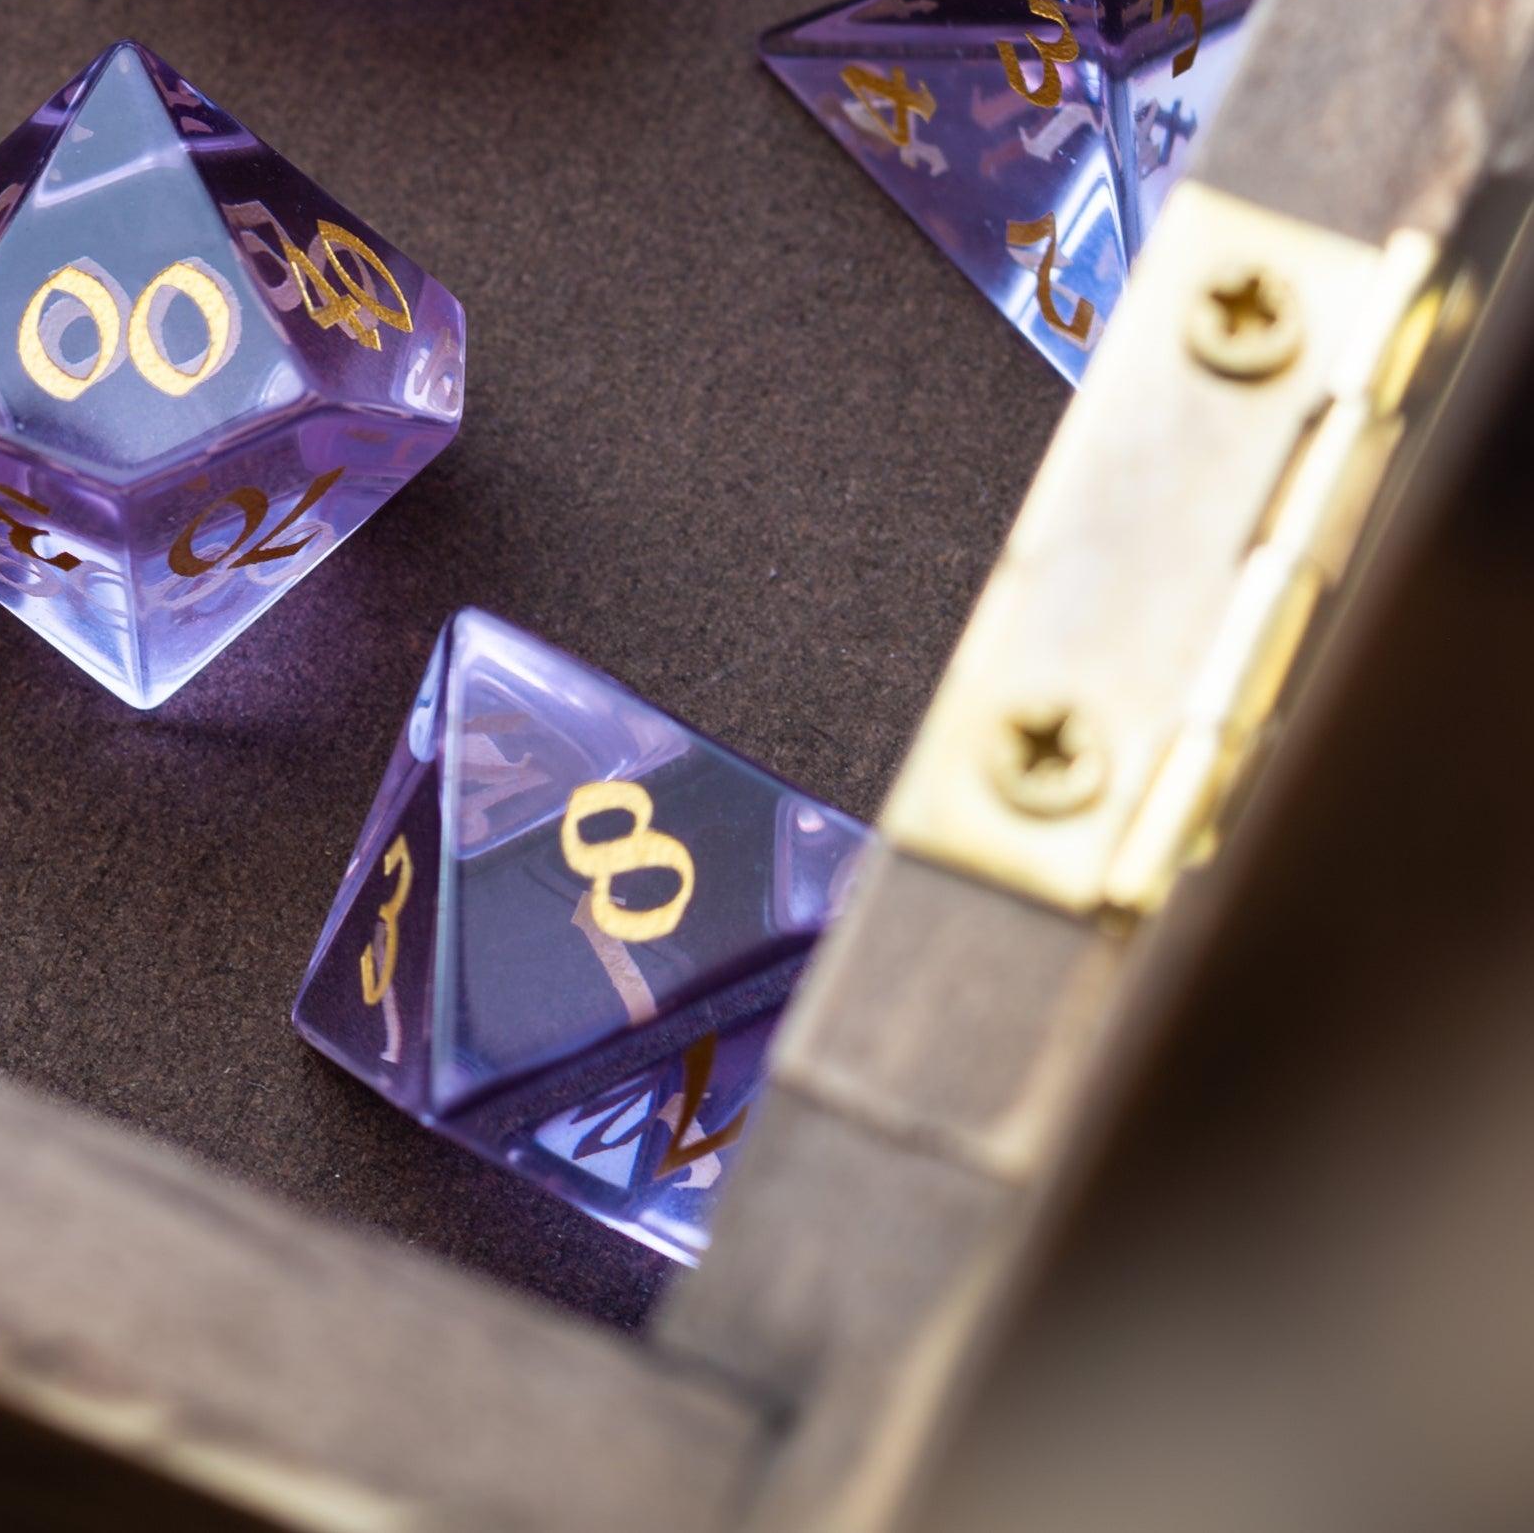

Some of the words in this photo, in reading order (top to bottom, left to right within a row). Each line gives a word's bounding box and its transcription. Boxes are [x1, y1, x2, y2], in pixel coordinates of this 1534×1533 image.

[841, 65, 936, 147] 4
[17, 262, 232, 403] 00
[282, 219, 414, 351] 40
[1006, 212, 1097, 344] 2
[360, 834, 413, 1006] 3
[560, 779, 695, 942] 8
